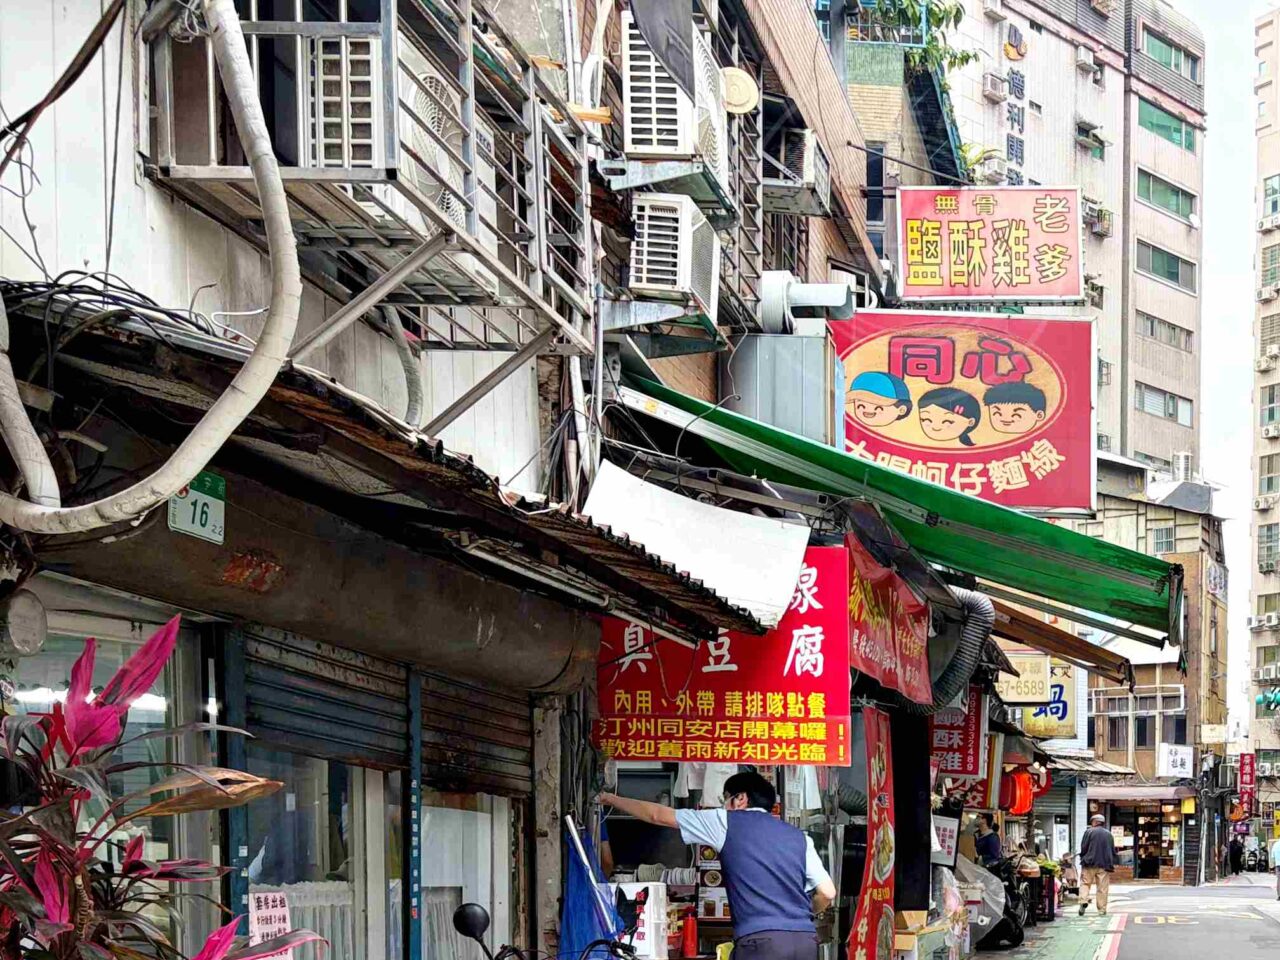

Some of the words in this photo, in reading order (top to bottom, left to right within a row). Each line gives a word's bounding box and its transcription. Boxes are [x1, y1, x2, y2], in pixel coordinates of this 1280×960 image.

[934, 195, 998, 215] 無骨
[905, 218, 1030, 288] 鹽酥雞
[1033, 194, 1072, 285] 老爹
[887, 335, 1033, 386] 同心
[191, 499, 209, 528] 16
[724, 691, 826, 719] 請排隊點餐
